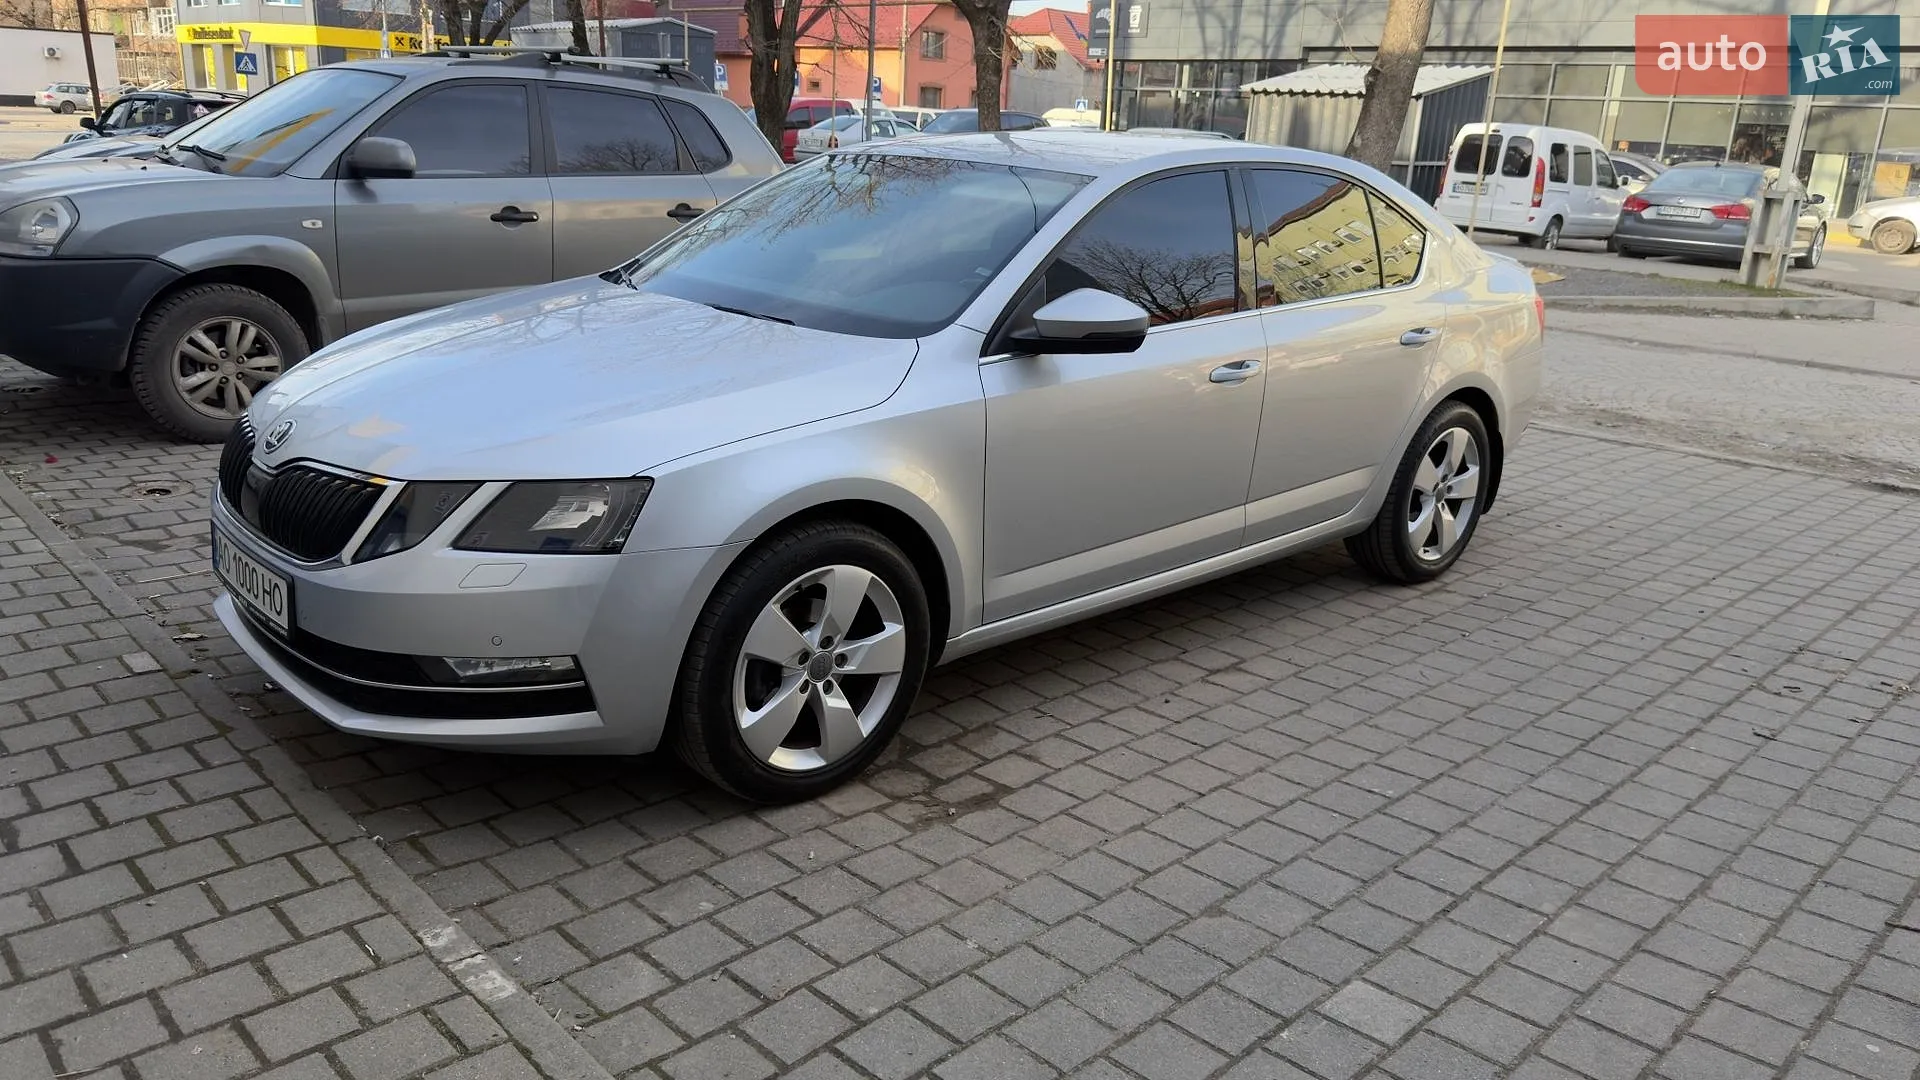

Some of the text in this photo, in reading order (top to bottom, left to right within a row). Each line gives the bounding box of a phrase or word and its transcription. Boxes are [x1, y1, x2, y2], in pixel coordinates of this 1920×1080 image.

[715, 65, 724, 80] P
[233, 552, 259, 600] 1000
[261, 573, 283, 617] HO
